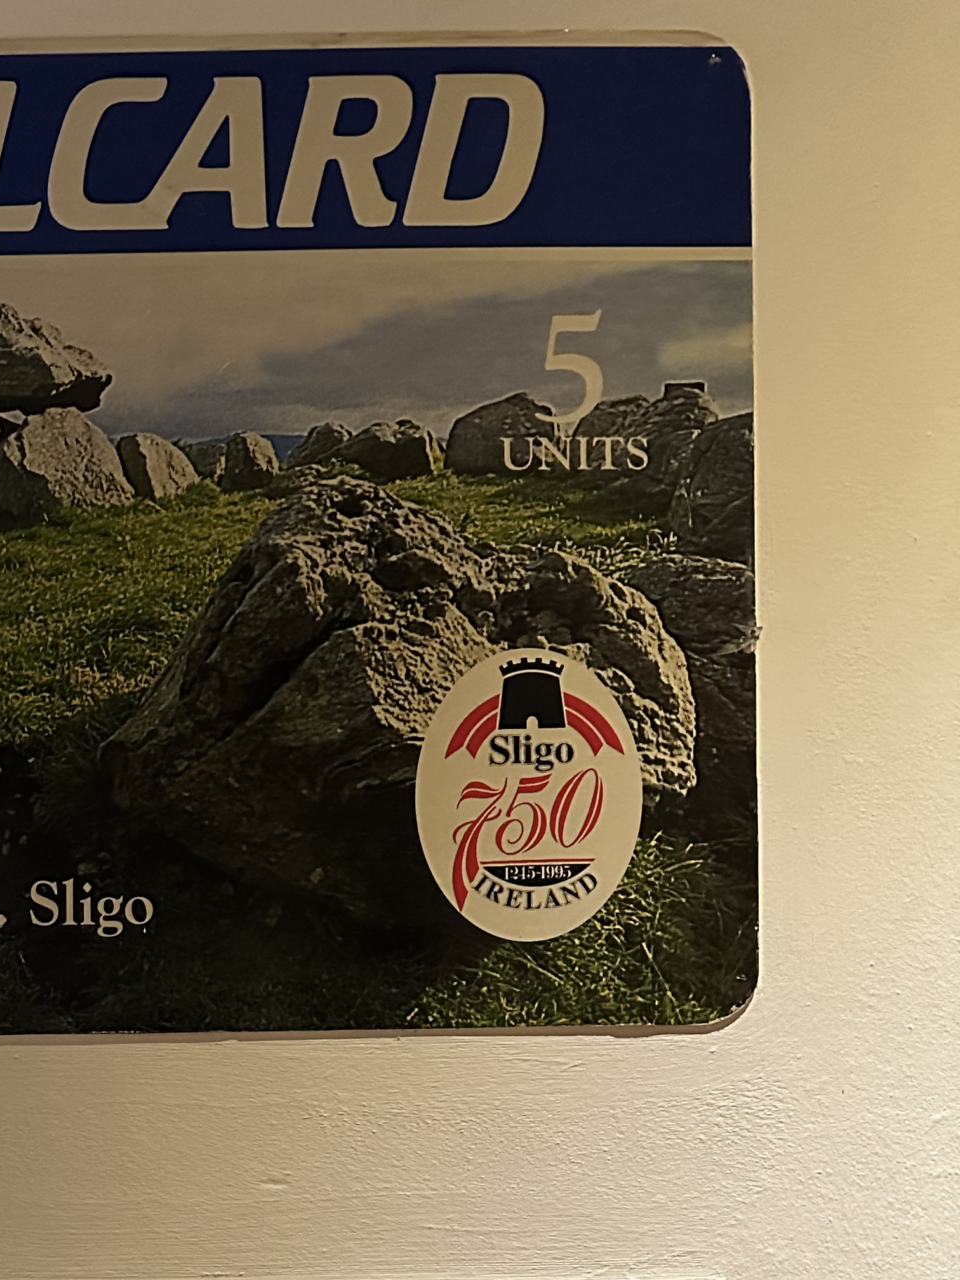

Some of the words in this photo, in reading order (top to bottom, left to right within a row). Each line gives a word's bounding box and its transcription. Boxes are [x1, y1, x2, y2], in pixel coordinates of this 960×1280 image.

[534, 308, 604, 424] 5
[499, 436, 649, 471] UNITS
[488, 734, 575, 771] Sligo
[452, 767, 604, 912] 750
[504, 865, 572, 880] 1245-1995
[29, 877, 155, 937] Sligo
[471, 873, 598, 910] IRELAND
